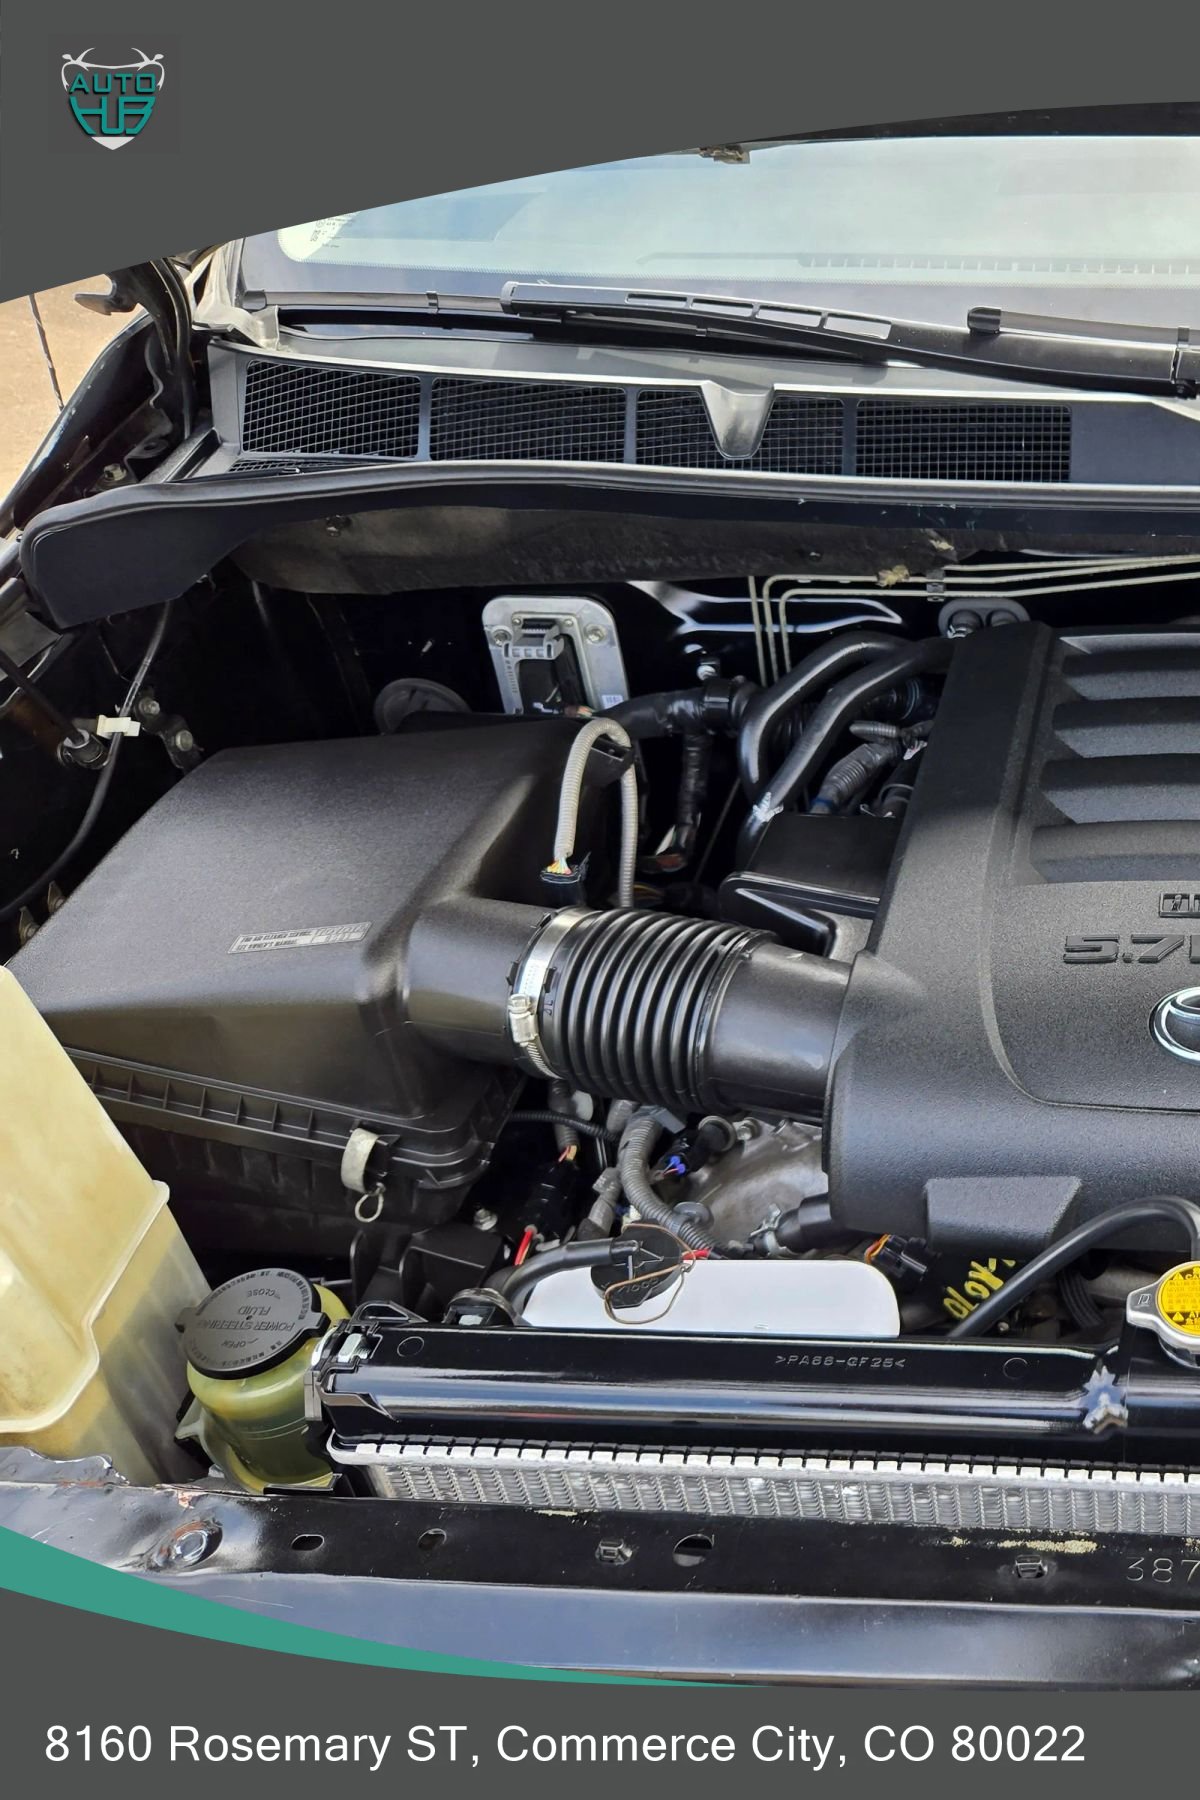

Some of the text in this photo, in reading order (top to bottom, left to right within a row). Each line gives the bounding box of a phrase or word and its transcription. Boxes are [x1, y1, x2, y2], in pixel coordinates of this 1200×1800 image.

[247, 1288, 276, 1298] CLOSE
[237, 1306, 272, 1316] FLUID
[254, 1321, 295, 1331] POWER
[220, 1340, 246, 1349] OPEN
